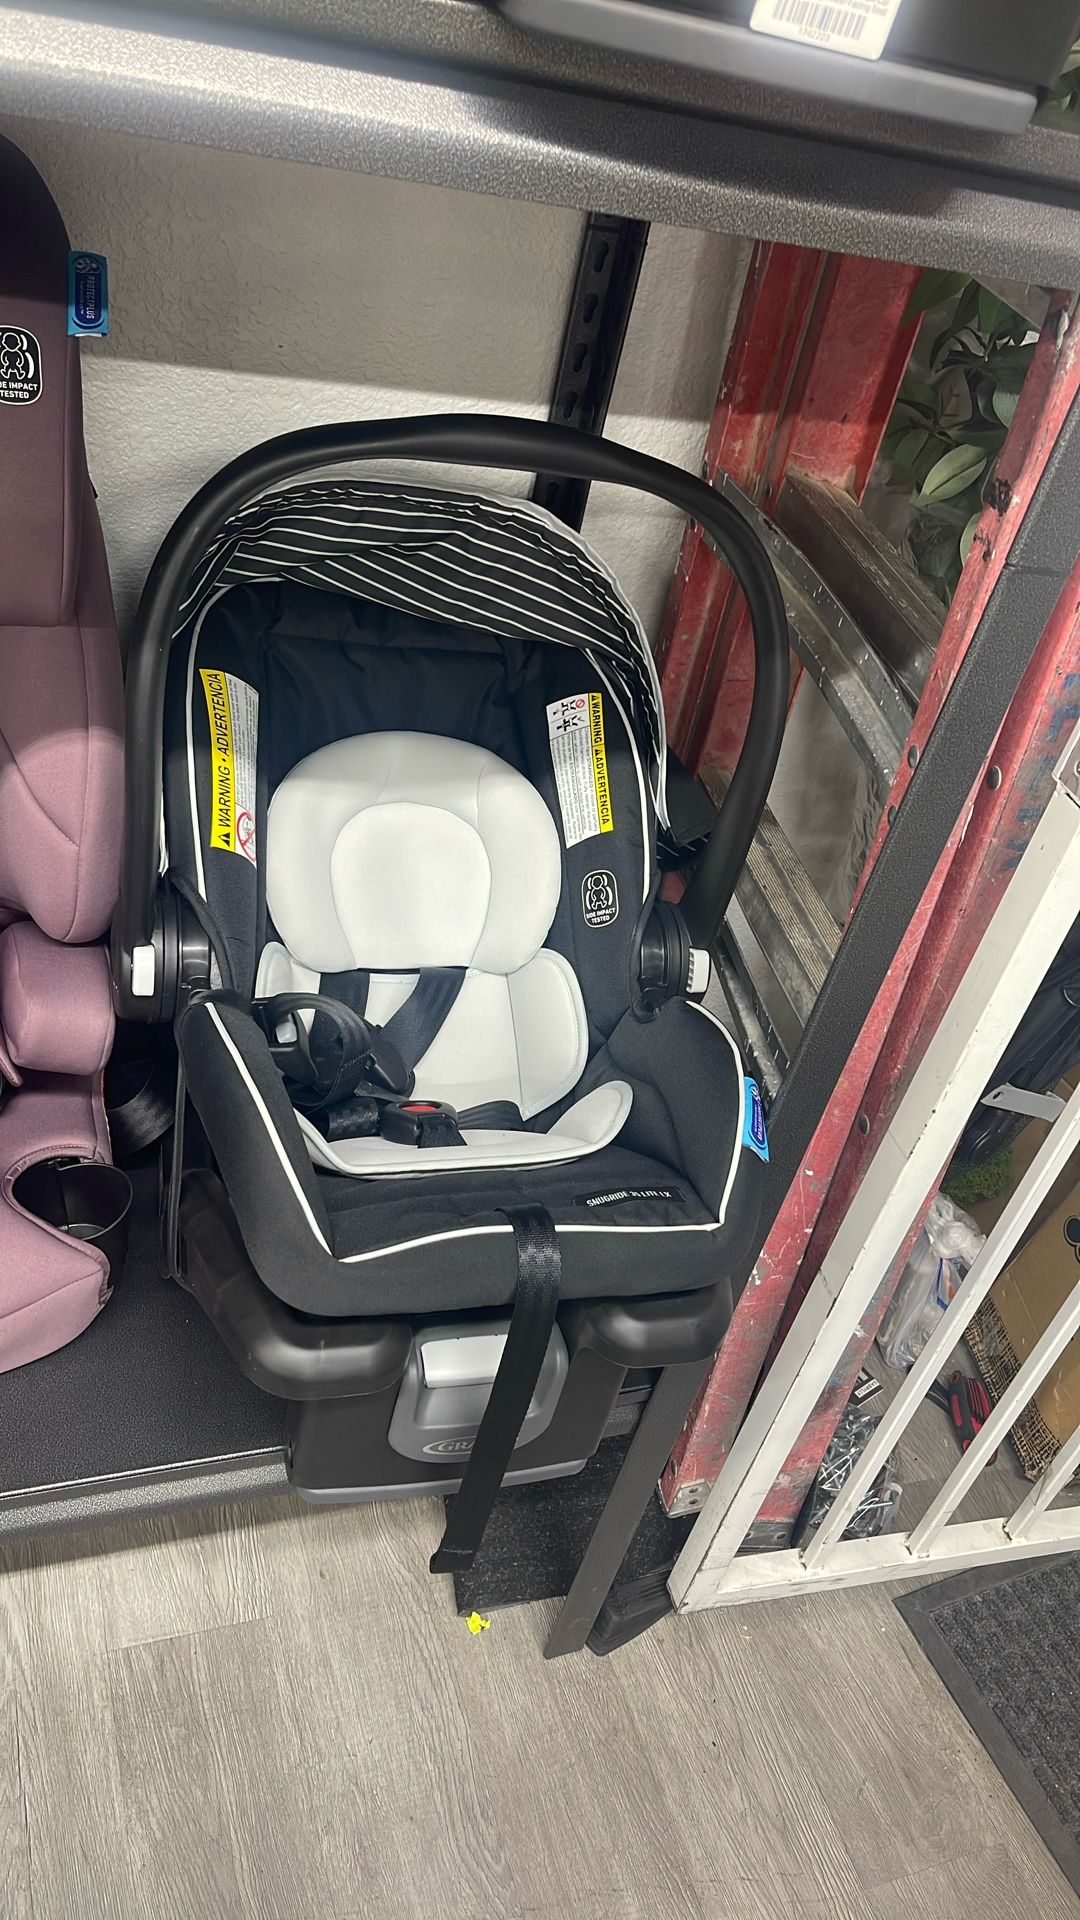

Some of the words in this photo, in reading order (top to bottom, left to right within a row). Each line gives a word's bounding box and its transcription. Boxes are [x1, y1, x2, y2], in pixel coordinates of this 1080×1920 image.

[86, 275, 95, 319] PROTECTPLUS
[0, 390, 29, 399] TESTED
[9, 381, 38, 391] IMPACT
[206, 673, 230, 757] ADVERTENCIA
[591, 702, 602, 743] WARNING
[218, 765, 231, 828] WARNING
[595, 757, 609, 824] ADVERTENCIA
[591, 915, 610, 923] TESTED
[597, 907, 616, 916] IMPACT
[586, 1190, 630, 1207] SNUGRIDE
